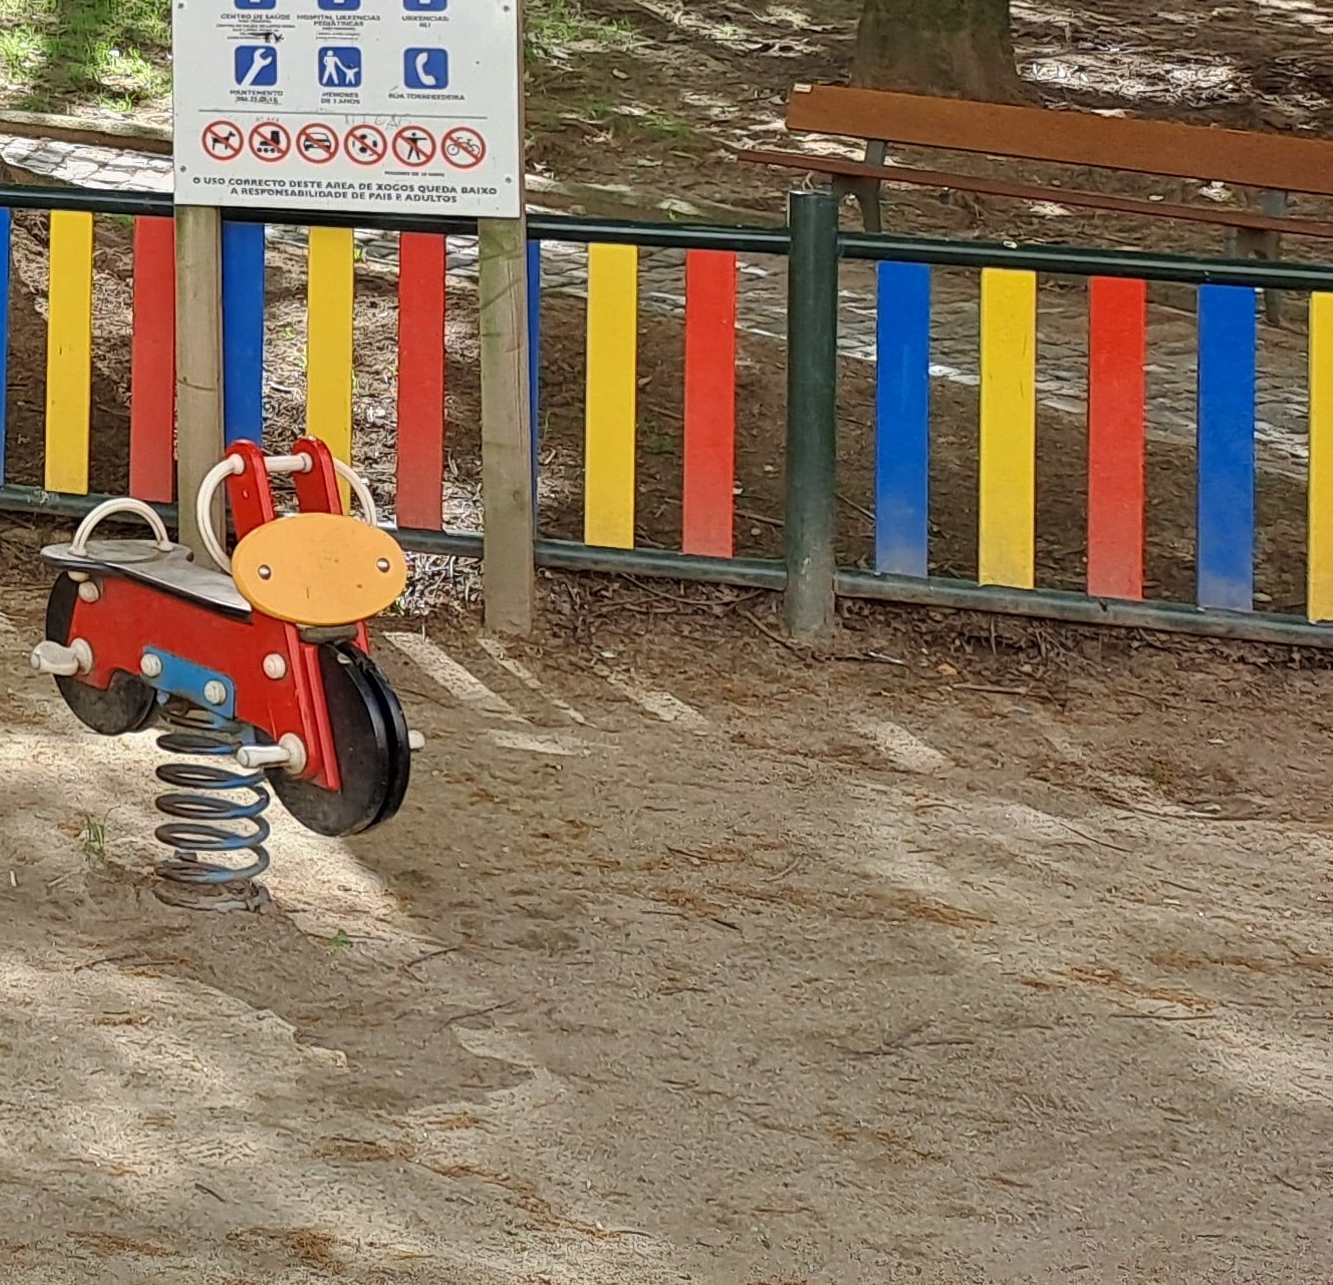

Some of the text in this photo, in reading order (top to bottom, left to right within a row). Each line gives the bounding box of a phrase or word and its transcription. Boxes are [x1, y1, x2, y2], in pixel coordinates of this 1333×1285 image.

[192, 176, 201, 185] O
[203, 176, 226, 185] USO
[228, 178, 287, 188] CORRECTO
[289, 179, 323, 189] DESTE
[358, 182, 373, 191] DE
[376, 183, 415, 193] XOGOS
[417, 185, 458, 194] QUEDA
[460, 186, 498, 195] BAIXO
[230, 187, 239, 195] A
[241, 187, 348, 199] RESPONSABILIDADE
[351, 191, 366, 200] DE
[404, 193, 457, 204] ADULTOS
